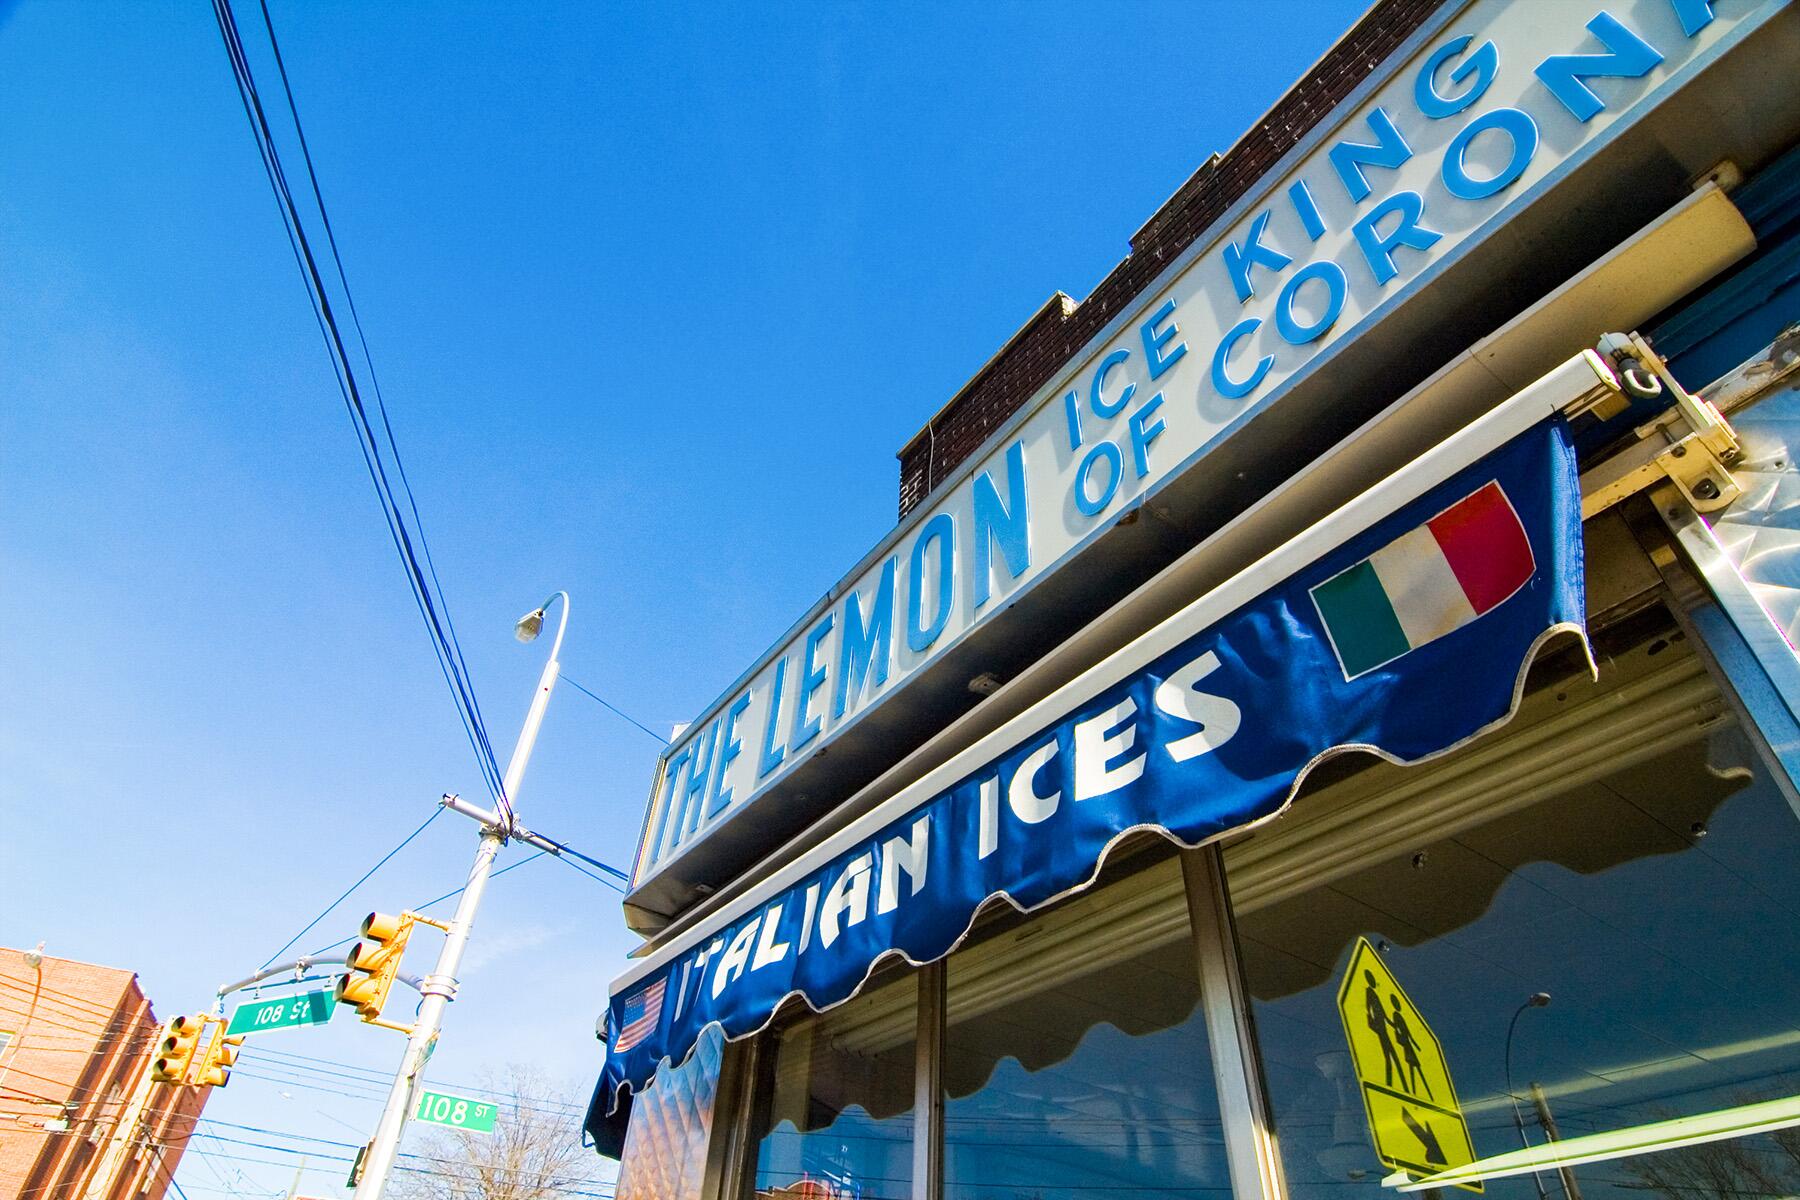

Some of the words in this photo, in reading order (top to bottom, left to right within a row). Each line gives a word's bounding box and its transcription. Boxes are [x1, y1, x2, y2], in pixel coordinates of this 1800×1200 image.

[1065, 298, 1188, 451] ICE
[1221, 33, 1500, 304] KING
[1074, 391, 1167, 517] OF
[1211, 0, 1714, 399] CORON
[651, 687, 752, 864] THE
[760, 439, 1032, 779] LEMON
[673, 814, 930, 1023] ITALIAN
[978, 649, 1242, 860] ICES
[253, 1004, 283, 1026] 108
[289, 1001, 311, 1020] St
[422, 1094, 468, 1125] 108
[474, 1104, 491, 1118] ST
